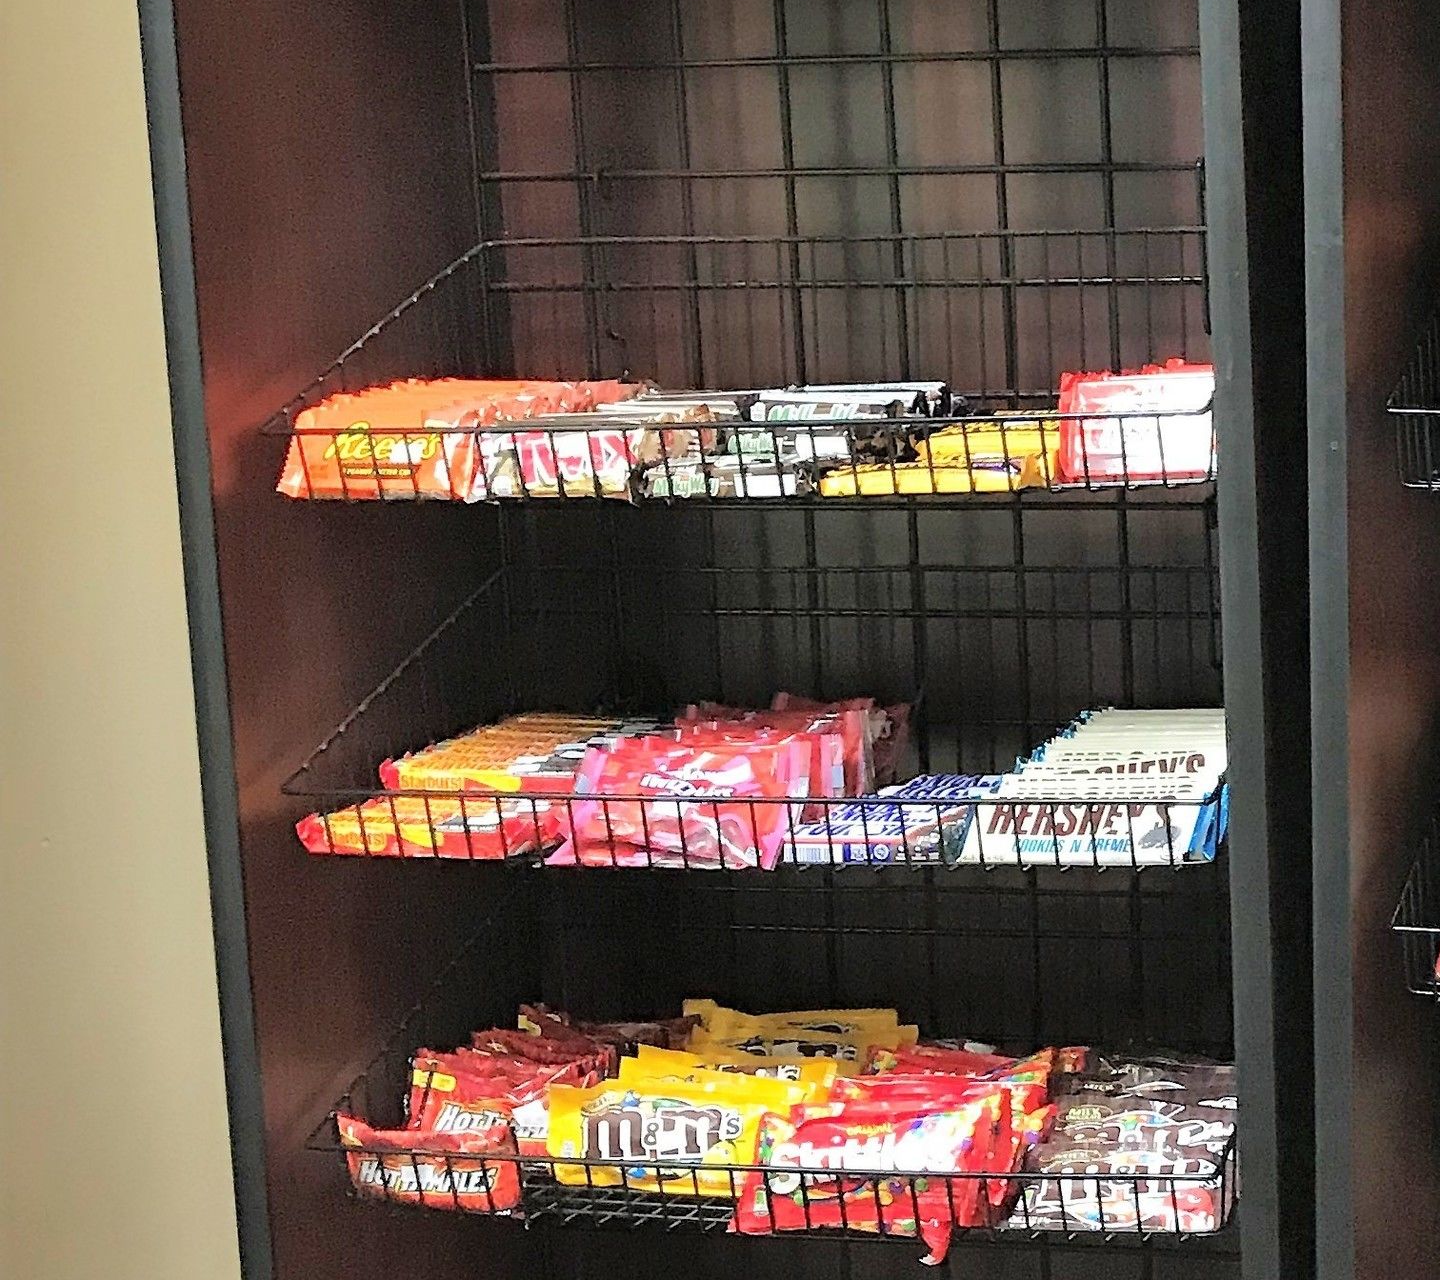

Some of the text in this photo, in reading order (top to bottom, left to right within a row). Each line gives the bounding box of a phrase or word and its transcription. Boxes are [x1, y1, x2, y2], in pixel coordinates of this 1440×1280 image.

[400, 774, 464, 789] Starburst
[986, 795, 1177, 837] HERSHEY'S
[1012, 838, 1132, 853] COOKIES CREME
[580, 1106, 740, 1161] m&m's
